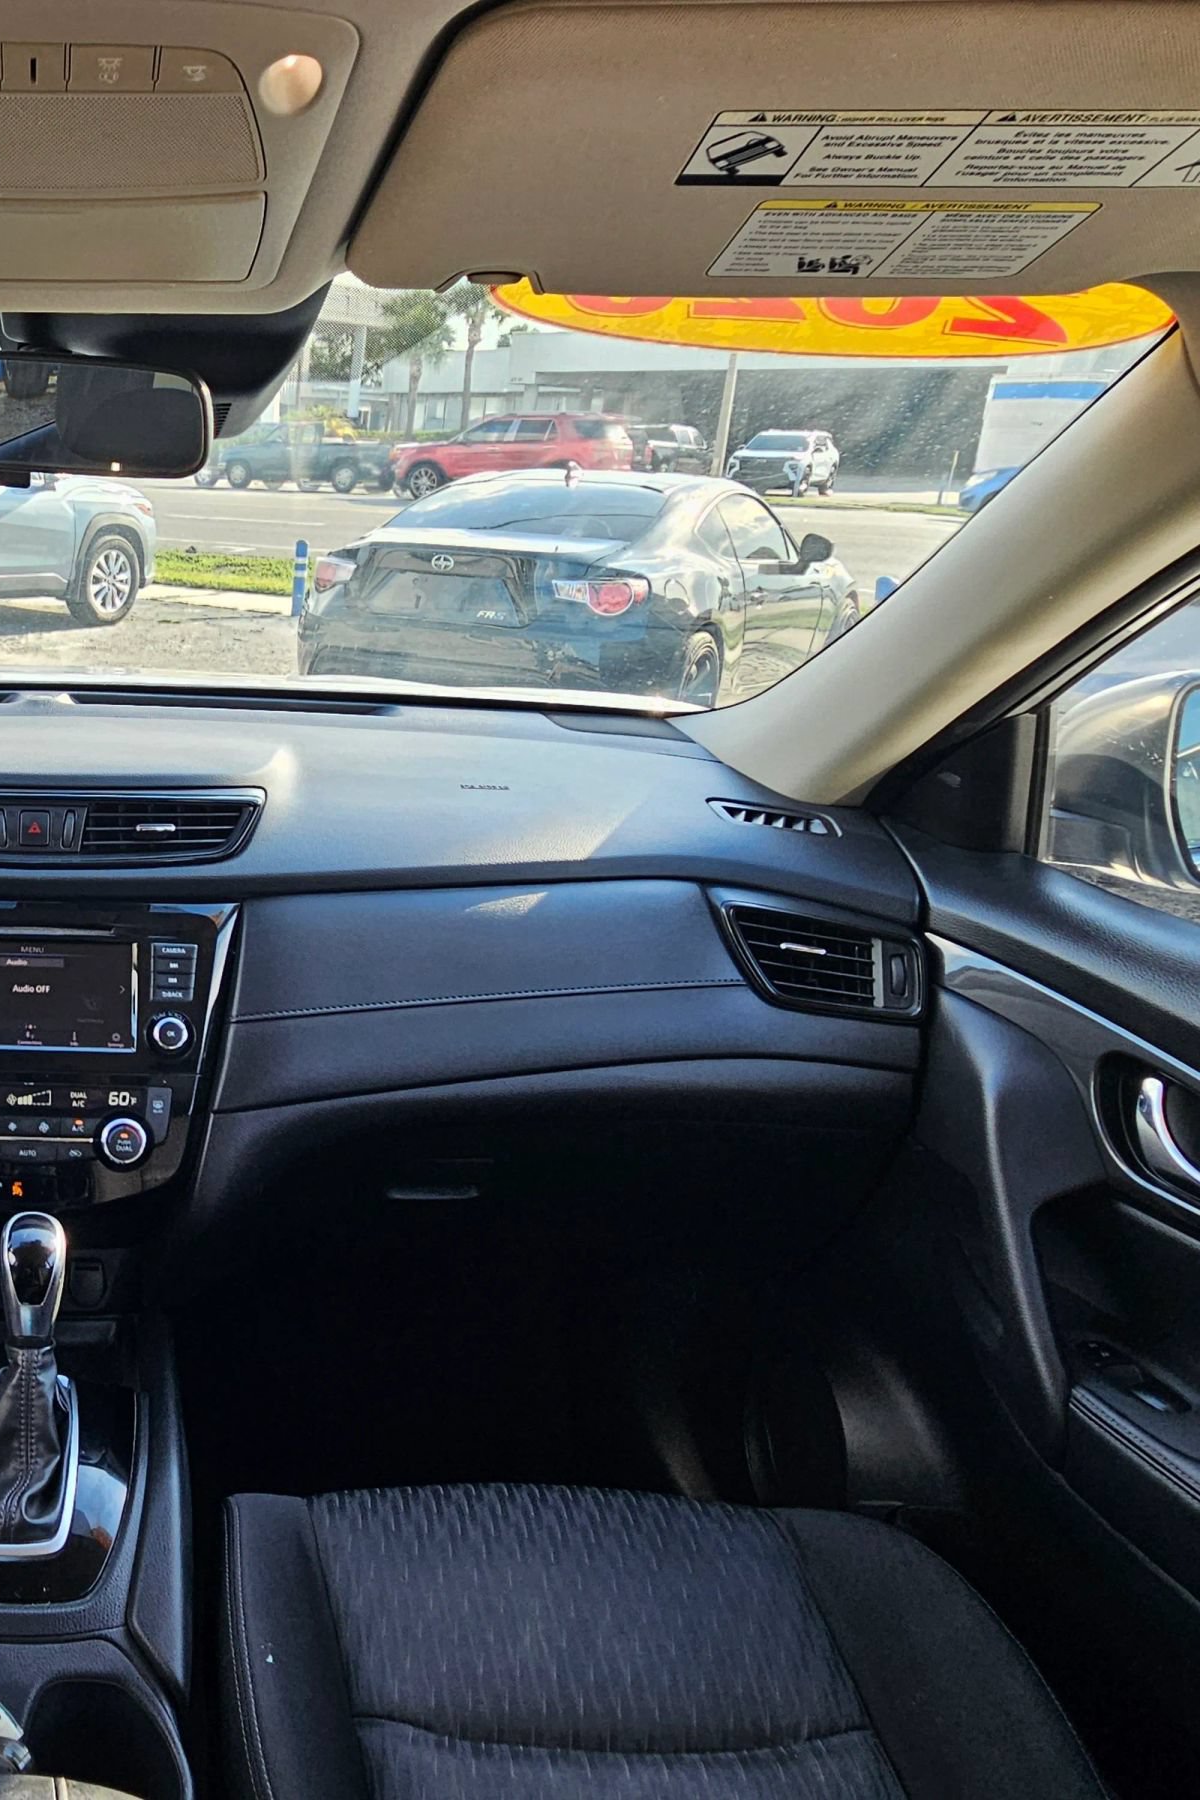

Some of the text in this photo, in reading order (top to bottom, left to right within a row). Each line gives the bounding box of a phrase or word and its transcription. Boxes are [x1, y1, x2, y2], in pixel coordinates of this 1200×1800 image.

[771, 114, 840, 122] WARNING:
[12, 985, 50, 993] Audio OFF
